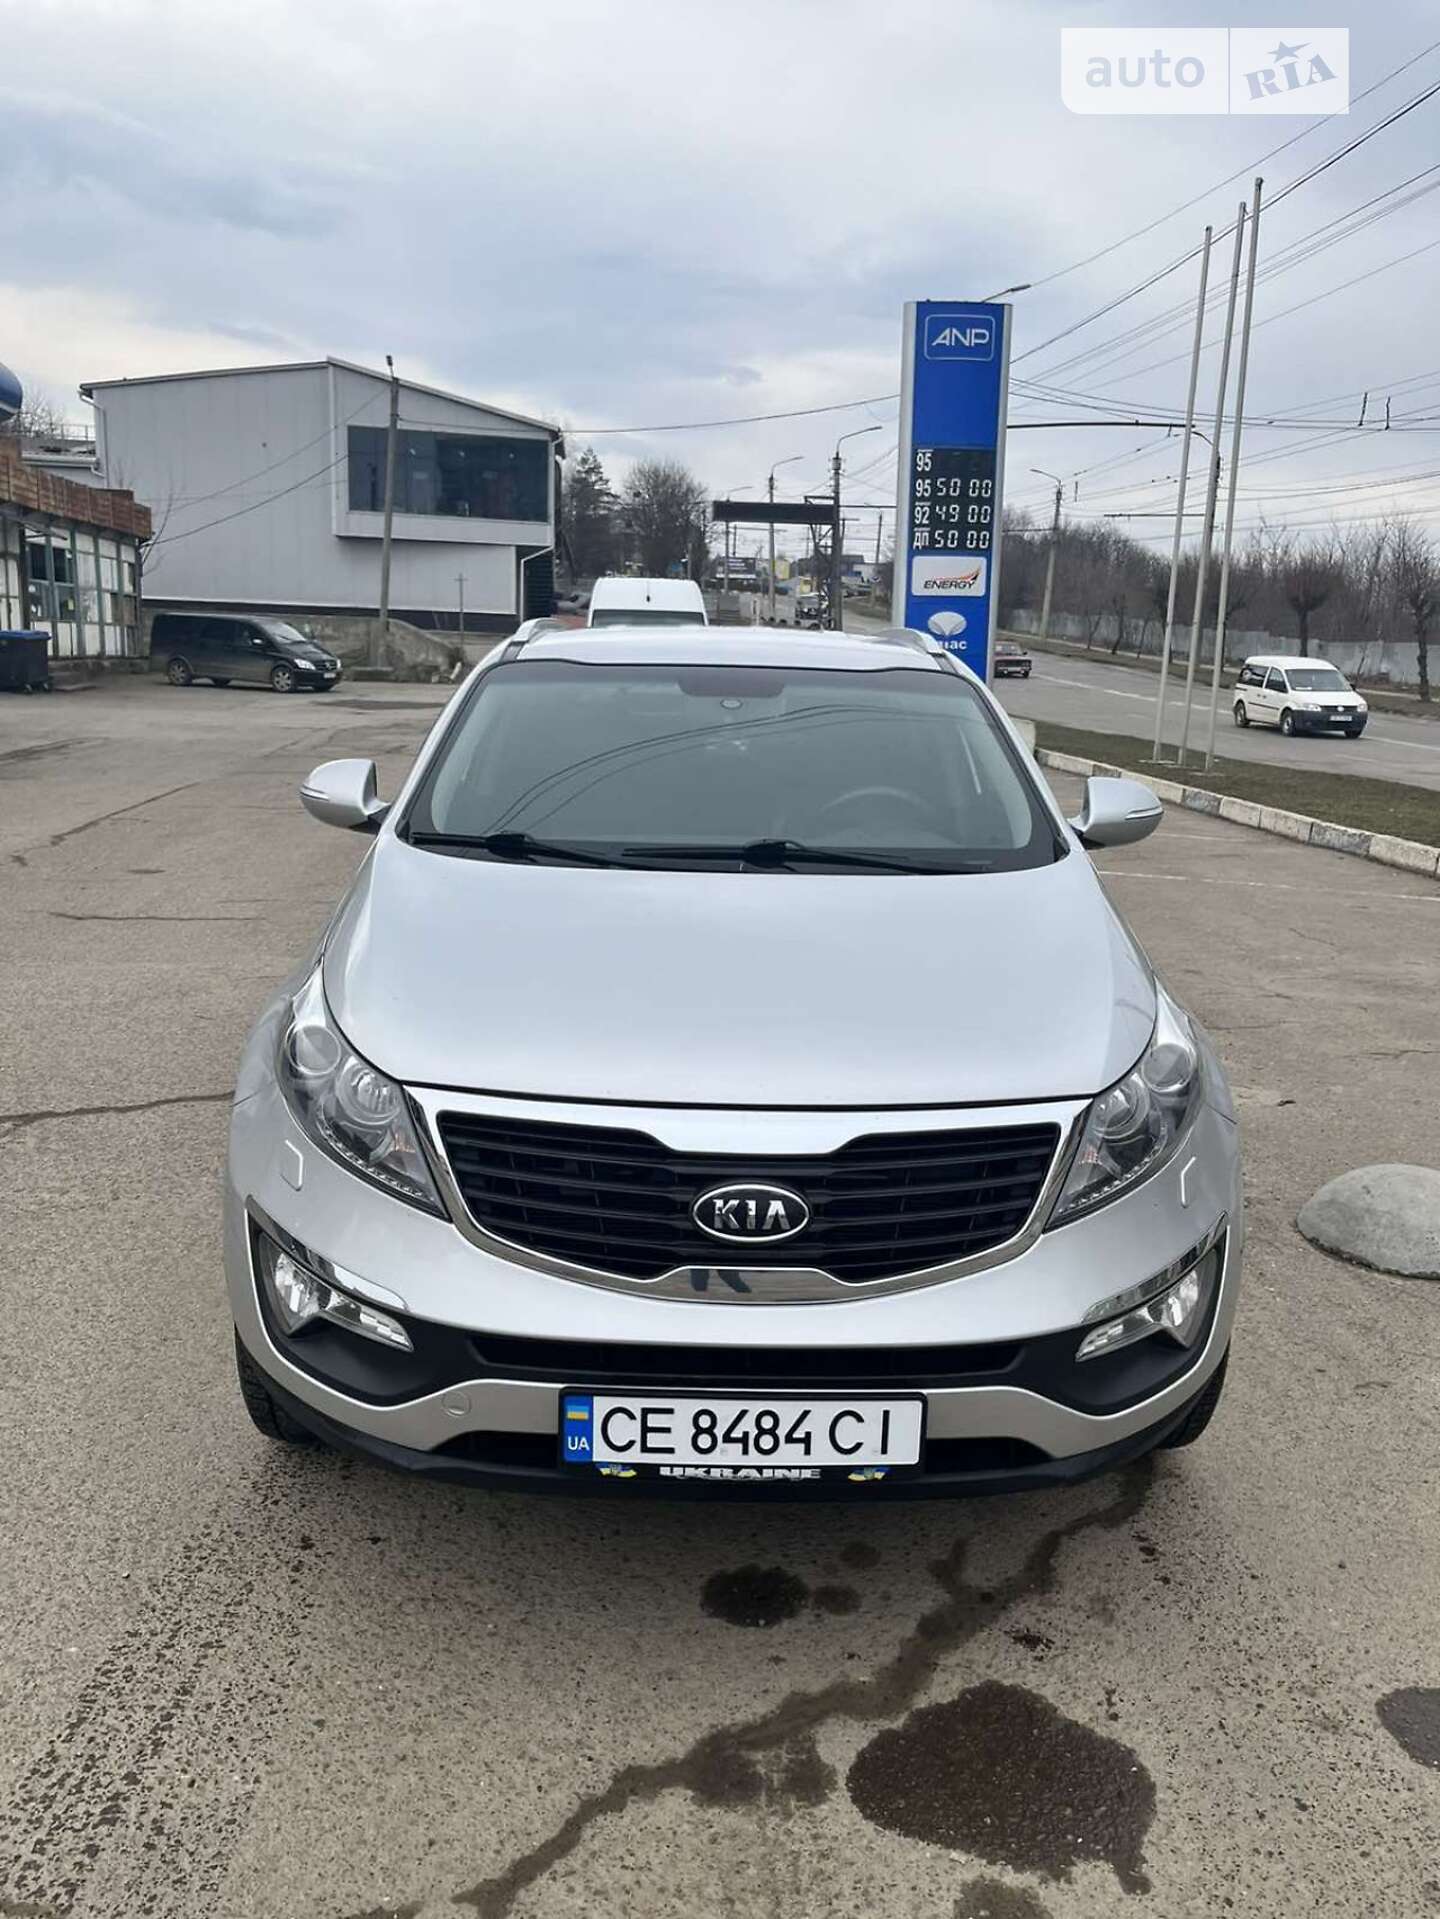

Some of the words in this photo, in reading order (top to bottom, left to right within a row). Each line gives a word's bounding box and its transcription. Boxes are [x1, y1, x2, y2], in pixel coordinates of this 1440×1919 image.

[931, 328, 990, 347] ANP
[916, 452, 932, 471] 95
[915, 478, 931, 497] 95
[914, 506, 930, 524] 92
[923, 579, 976, 590] ENERGY
[712, 1199, 791, 1230] KIA
[601, 1406, 675, 1454] CE
[690, 1408, 812, 1456] 8484
[828, 1409, 890, 1455] CI
[568, 1437, 590, 1452] UA
[659, 1466, 822, 1479] UKRAINE
